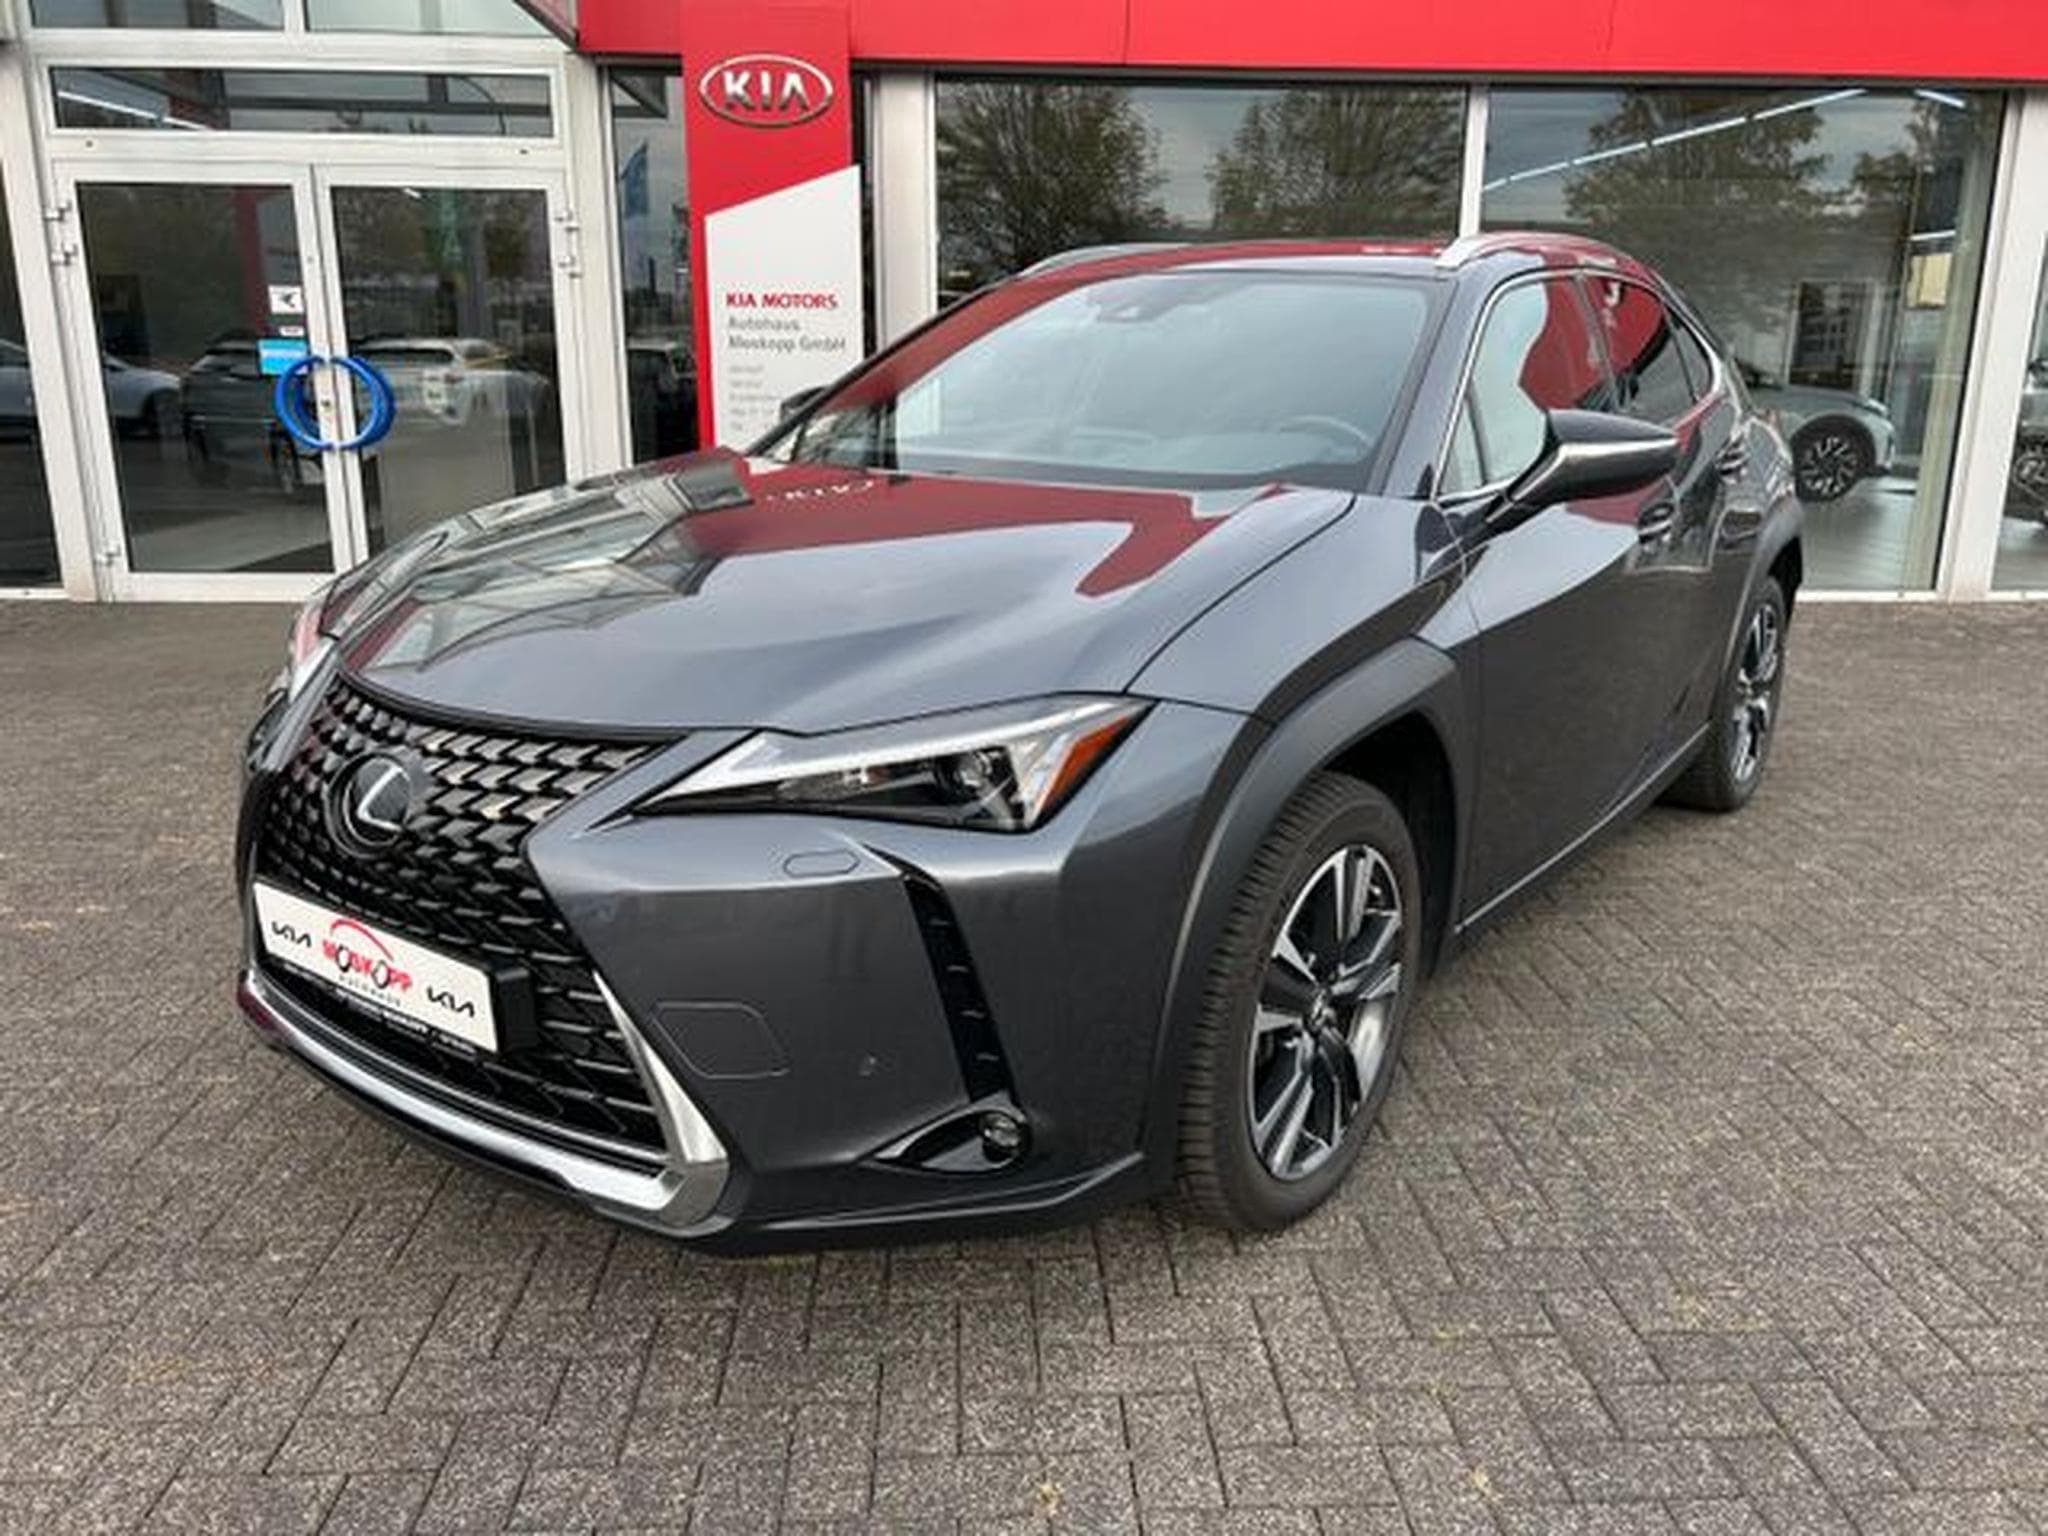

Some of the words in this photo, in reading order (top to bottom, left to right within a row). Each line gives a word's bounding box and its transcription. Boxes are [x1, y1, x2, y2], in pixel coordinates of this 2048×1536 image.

[723, 71, 809, 110] KIA
[726, 293, 757, 307] KIA
[762, 294, 838, 309] MOTORS
[729, 316, 799, 331] Autohaus
[798, 335, 846, 352] GmbH
[427, 986, 475, 1018] KIA
